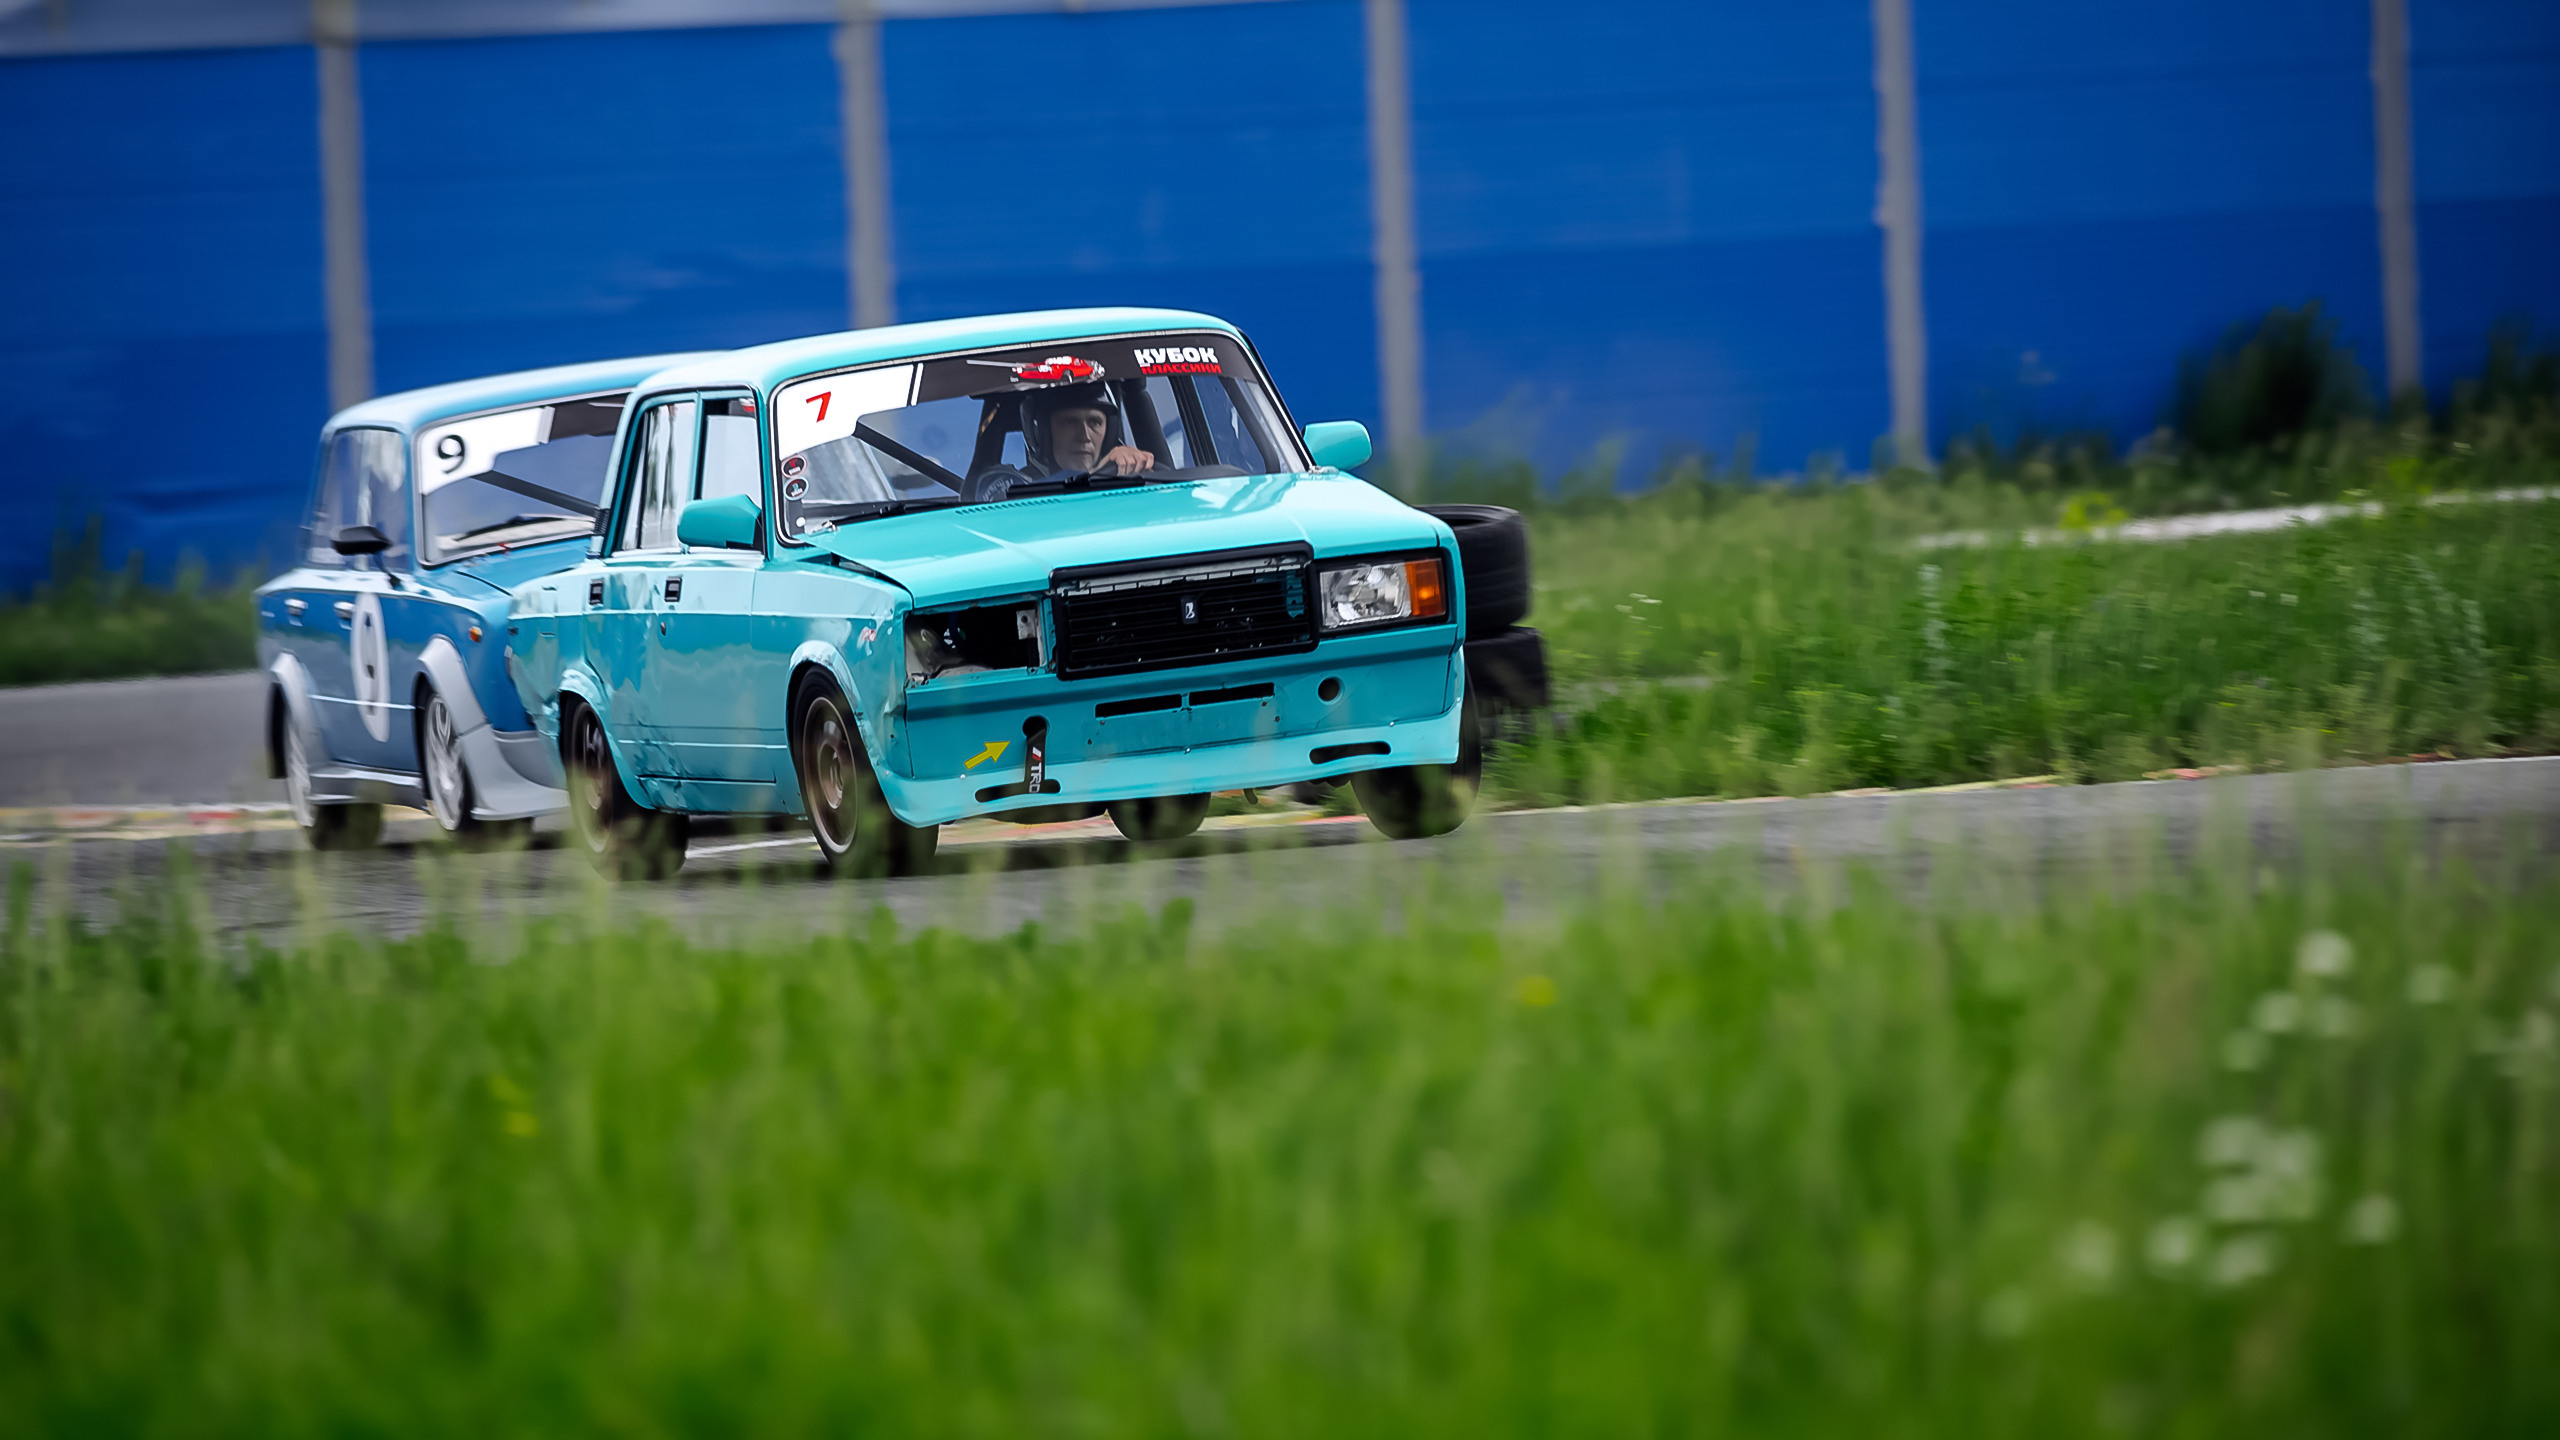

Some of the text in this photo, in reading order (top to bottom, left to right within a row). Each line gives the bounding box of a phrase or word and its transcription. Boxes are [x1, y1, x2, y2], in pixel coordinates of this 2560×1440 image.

[1133, 347, 1219, 367] КУБОК
[806, 391, 831, 423] 7
[437, 434, 465, 475] 9
[1028, 762, 1042, 793] TRD
